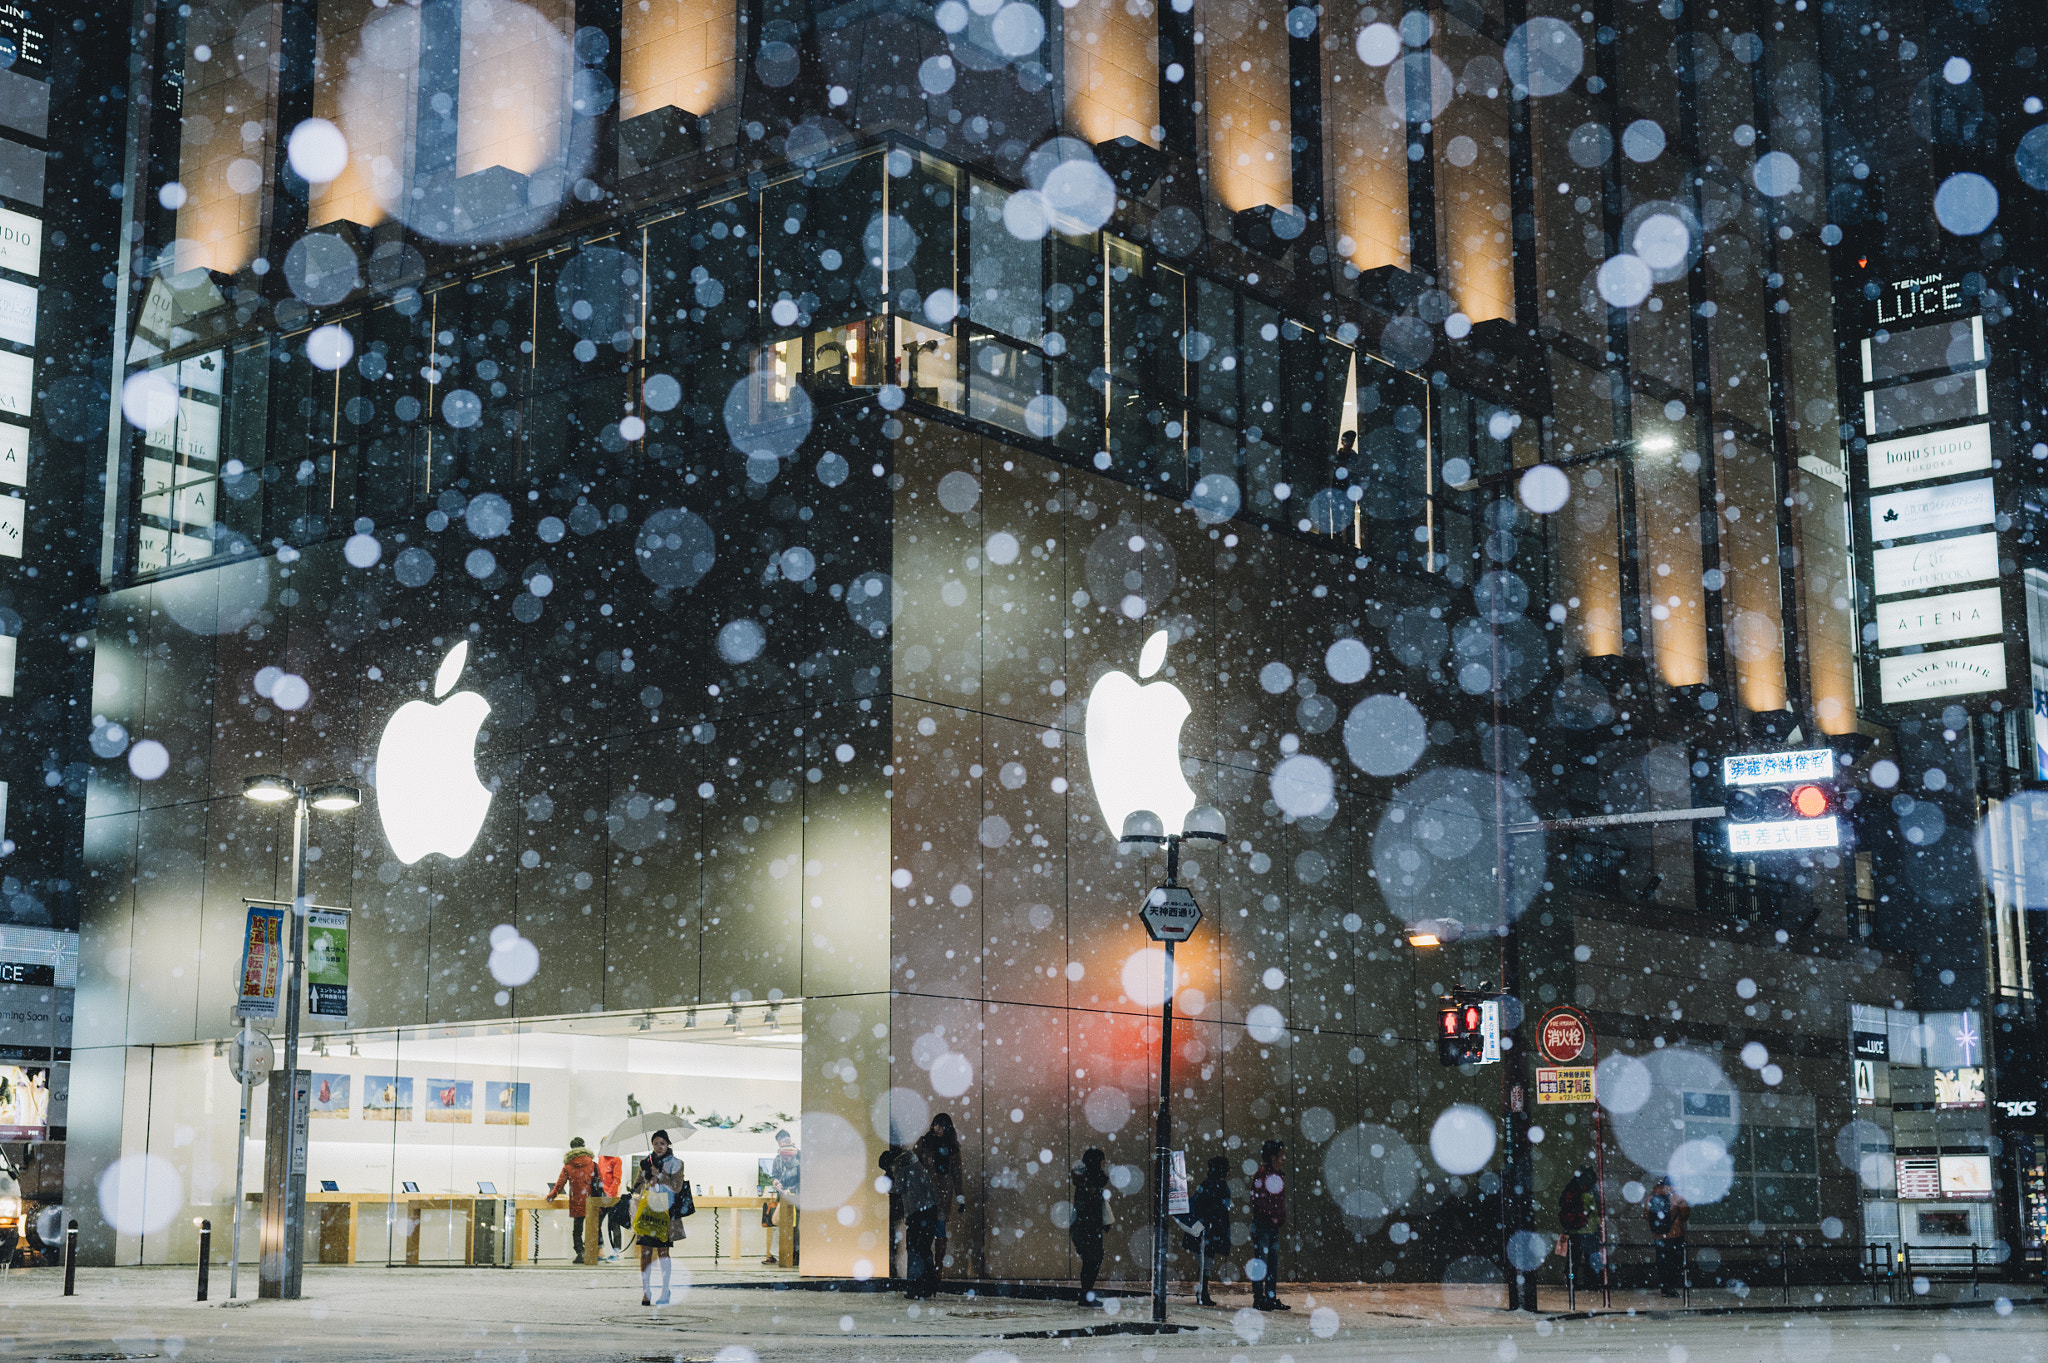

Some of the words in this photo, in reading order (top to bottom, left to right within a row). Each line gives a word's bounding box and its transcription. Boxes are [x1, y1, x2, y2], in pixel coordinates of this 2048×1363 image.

[1892, 273, 1942, 290] TENJIN
[1877, 282, 1962, 324] LUCE
[1923, 441, 1972, 458] STUDIO
[1906, 459, 1954, 473] FUKUOKA
[1898, 608, 1980, 630] ATENA
[1896, 663, 1940, 688] FRANCK
[1945, 660, 1991, 678] MULLER
[1735, 824, 1831, 846] 時差式信号
[1149, 906, 1196, 918] 天神西通り
[27, 1011, 49, 1022] Soon
[1547, 1028, 1582, 1047] 消火栓
